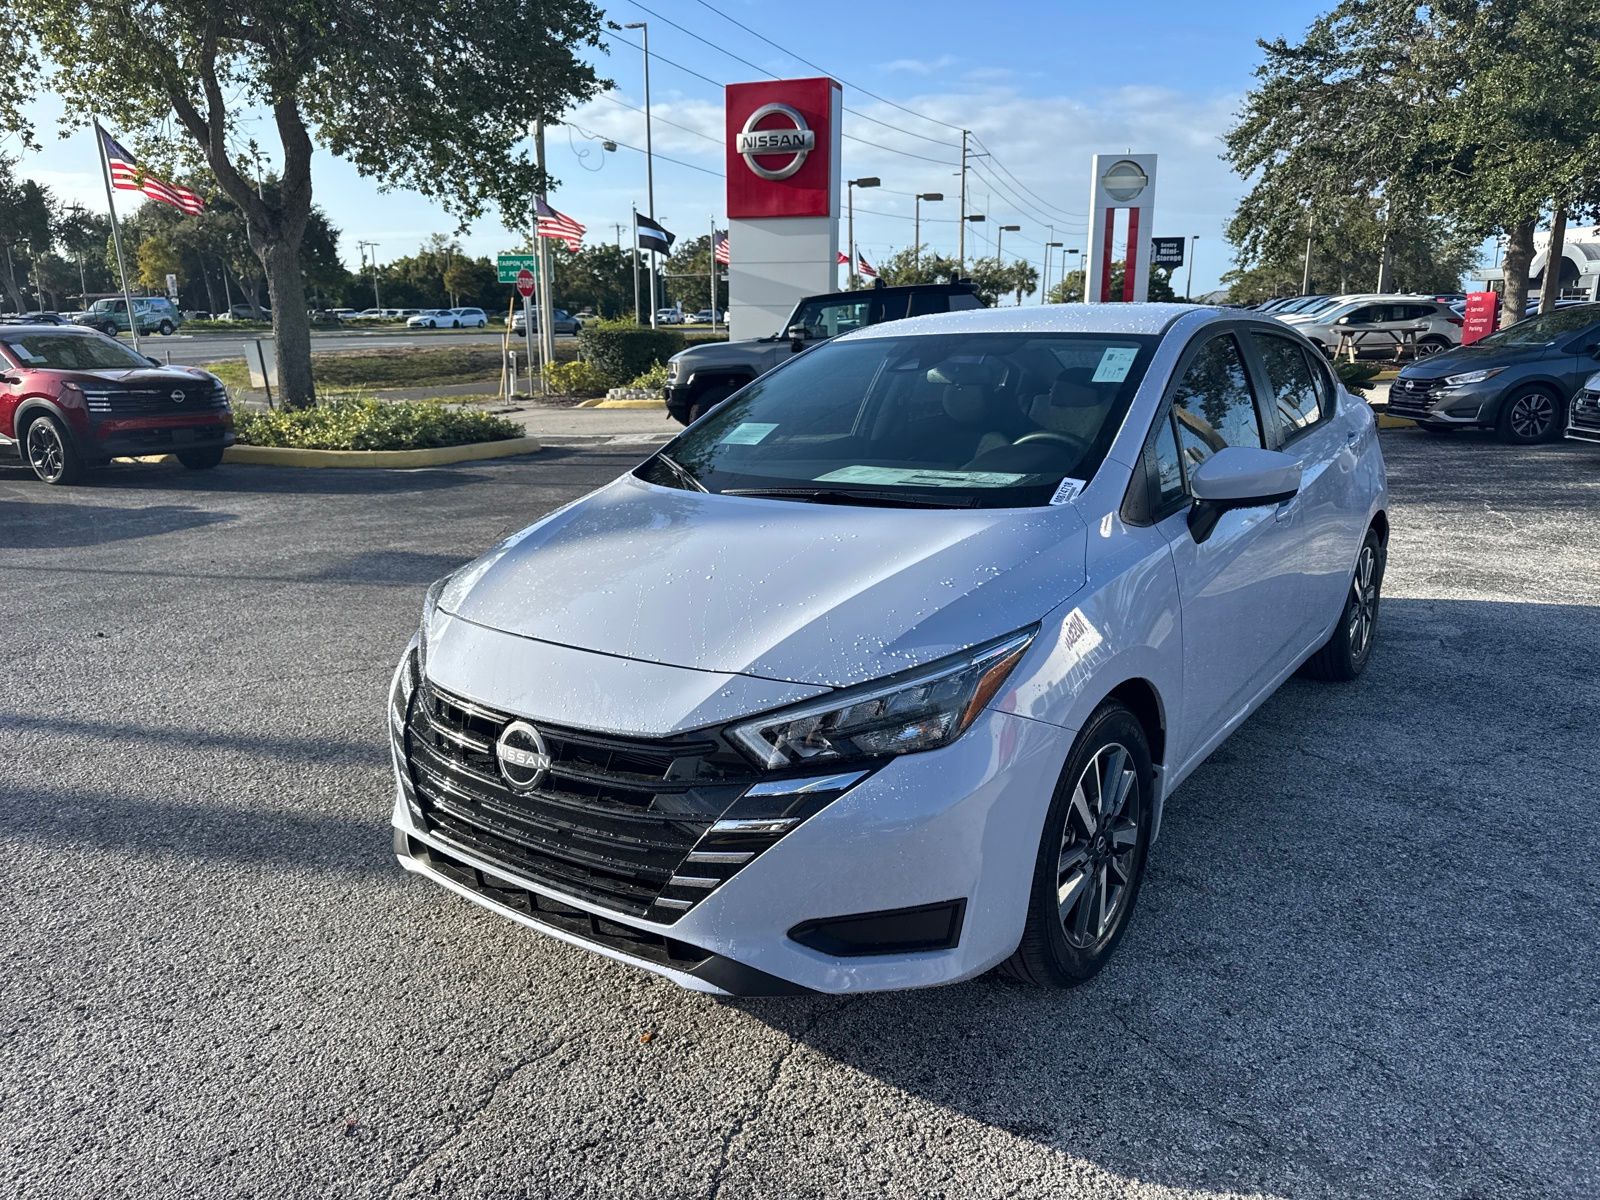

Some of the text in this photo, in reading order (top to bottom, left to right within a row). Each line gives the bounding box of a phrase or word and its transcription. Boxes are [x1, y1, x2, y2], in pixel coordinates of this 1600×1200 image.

[742, 134, 805, 148] NISSAN
[519, 277, 534, 288] STOP
[496, 742, 549, 768] NISSAN
